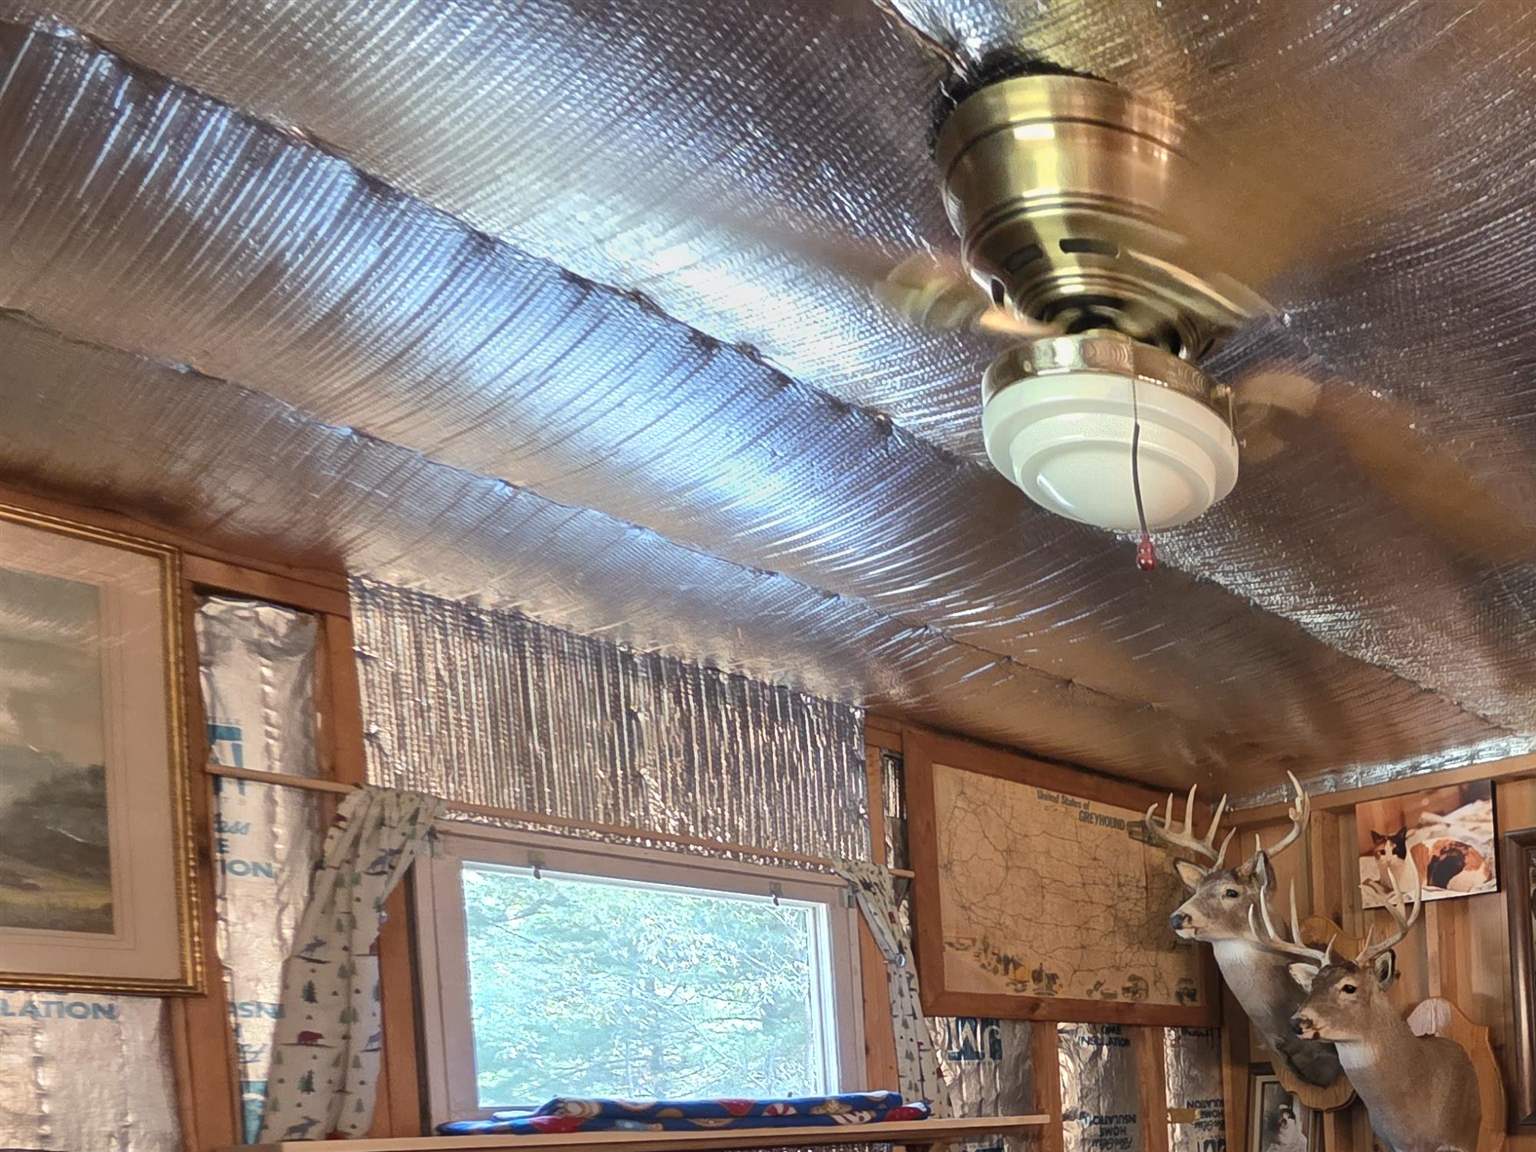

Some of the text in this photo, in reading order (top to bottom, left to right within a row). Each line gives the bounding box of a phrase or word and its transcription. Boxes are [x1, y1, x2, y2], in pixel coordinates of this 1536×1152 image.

[1037, 789, 1059, 804] United
[1061, 795, 1081, 809] States
[1079, 810, 1125, 830] GREYHOUND
